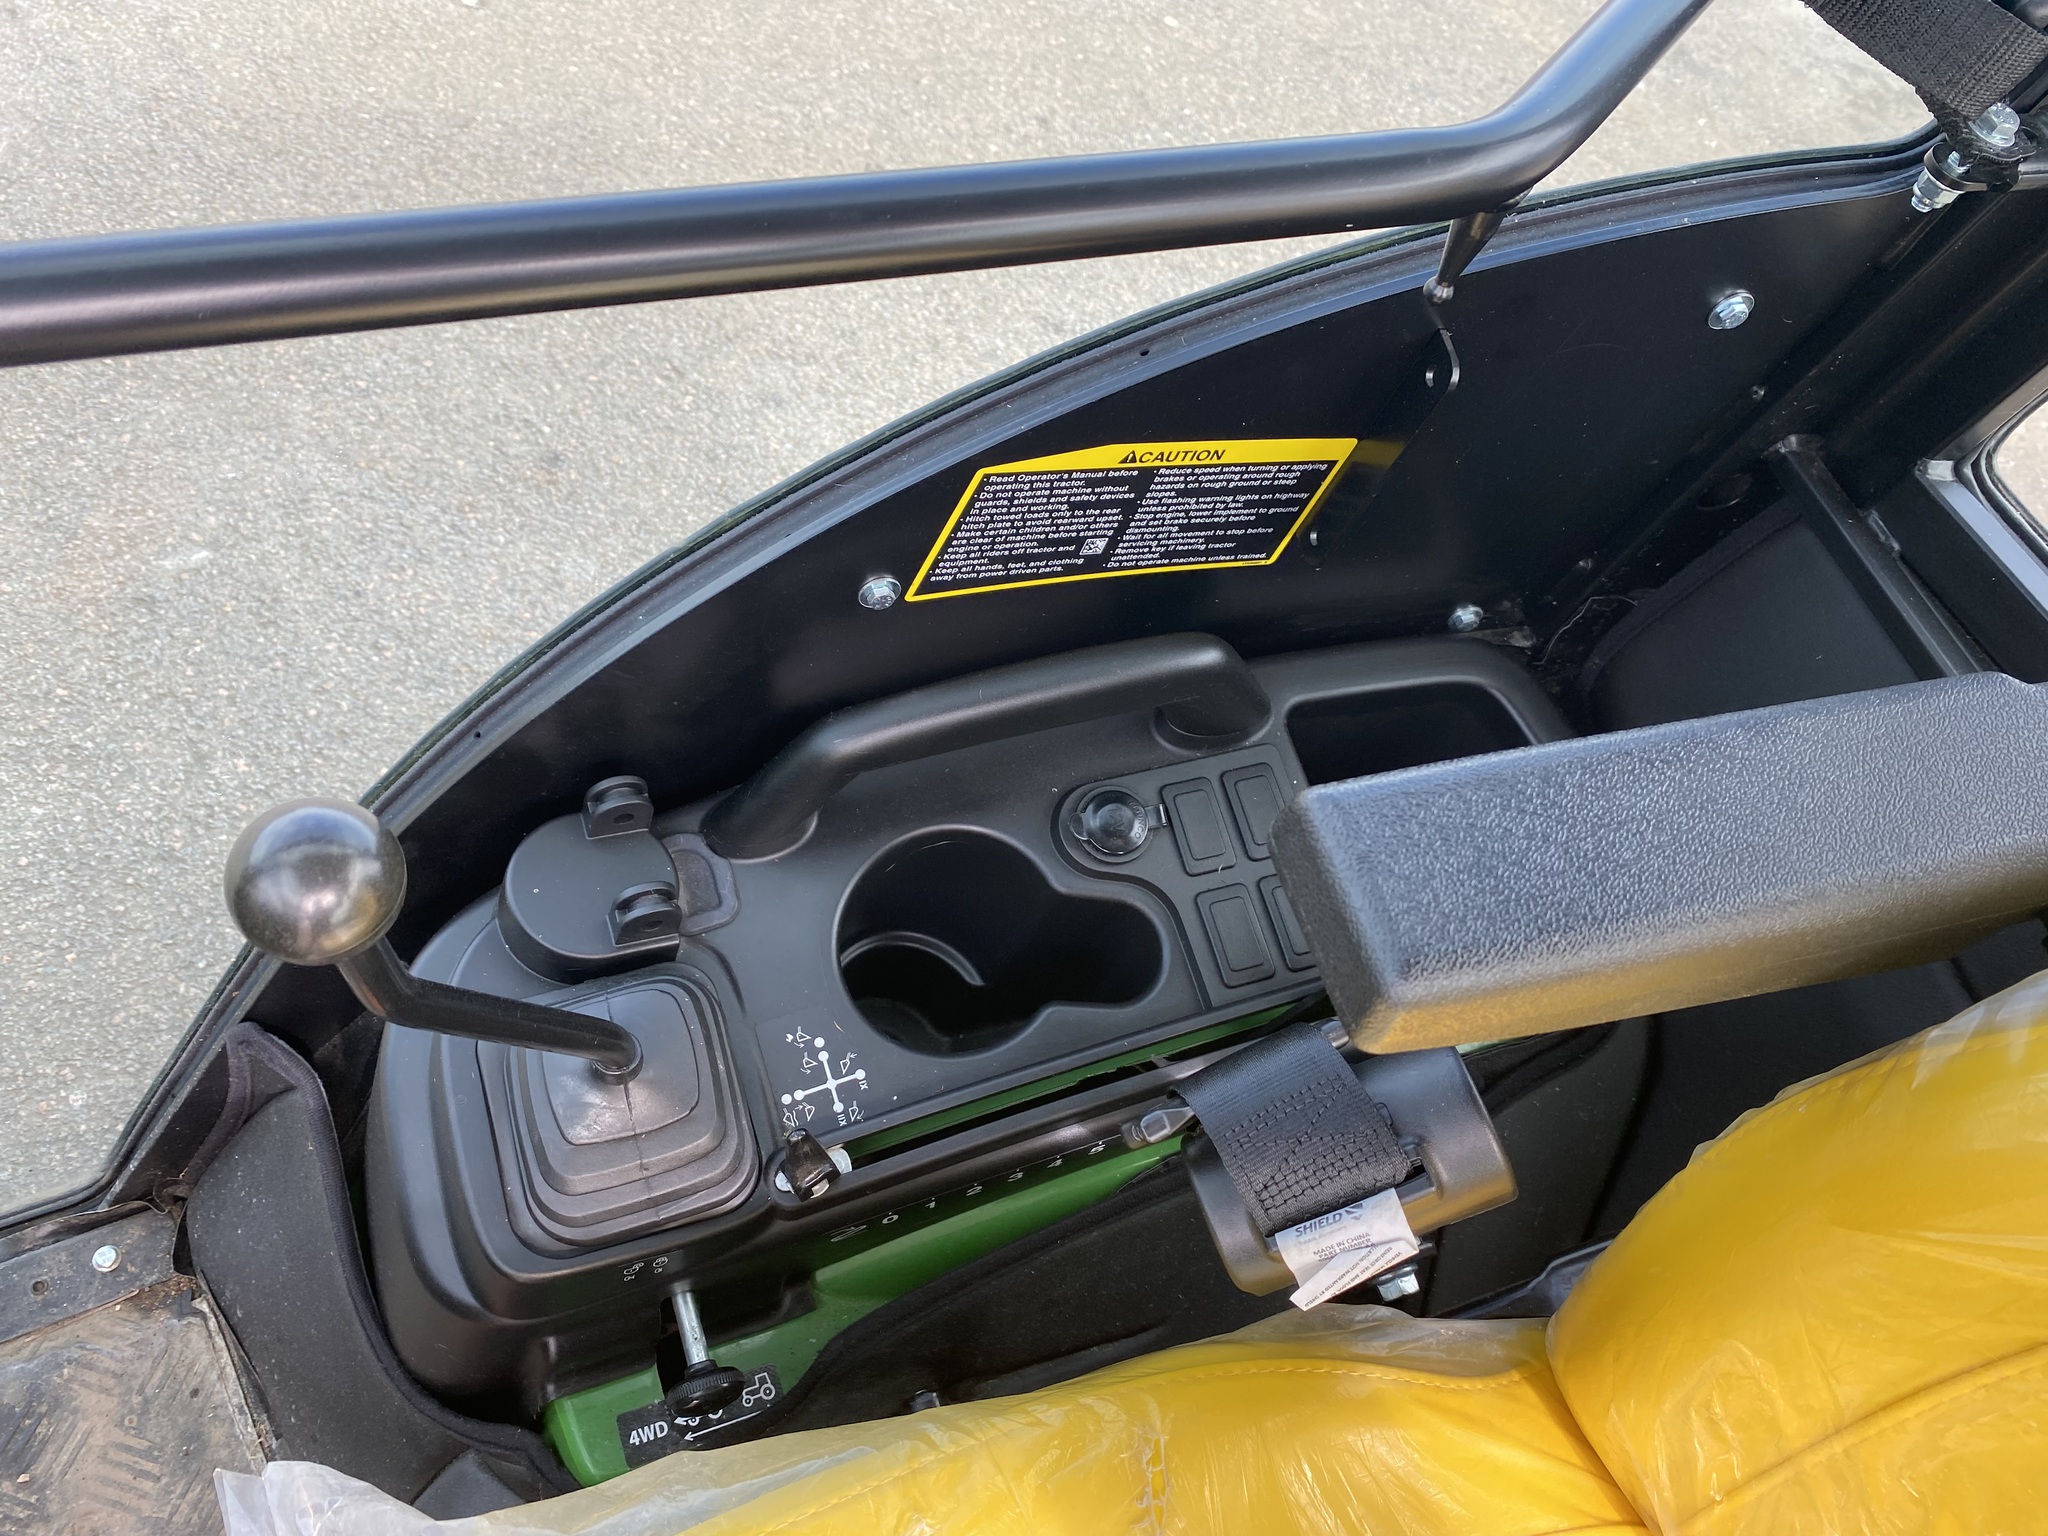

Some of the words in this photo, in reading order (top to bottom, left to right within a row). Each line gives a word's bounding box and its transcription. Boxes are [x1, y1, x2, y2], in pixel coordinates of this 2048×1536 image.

[1138, 449, 1226, 463] CAUTION
[1194, 466, 1221, 474] speed
[1291, 463, 1327, 471] applying
[1017, 473, 1069, 481] Operator's
[1198, 474, 1240, 482] operating
[984, 483, 1030, 491] operating
[1228, 480, 1261, 488] ground
[1014, 489, 1050, 497] operate
[975, 499, 1010, 507] guards,
[1169, 503, 1214, 512] prohibited
[1213, 508, 1257, 516] implement
[1269, 506, 1298, 514] ground
[988, 521, 1011, 529] plate
[1053, 516, 1094, 524] rearward
[1096, 515, 1123, 523] upset.
[1170, 530, 1214, 538] movement
[947, 545, 979, 553] engine
[993, 542, 1038, 550] operation.
[939, 558, 991, 567] equipment.
[1137, 558, 1169, 566] operate
[1039, 566, 1063, 574] parts.
[882, 1214, 899, 1224] 0
[925, 1201, 936, 1209] 1
[965, 1185, 983, 1197] 2
[1007, 1171, 1024, 1182] 3
[1047, 1158, 1063, 1168] 4
[1295, 1212, 1343, 1237] SHIELD
[1313, 1243, 1336, 1256] MADE
[1336, 1240, 1346, 1248] IN
[1346, 1232, 1371, 1245] CHINA
[1318, 1250, 1338, 1259] PART
[1339, 1238, 1372, 1253] NUMBER
[629, 1421, 669, 1445] 4WD
